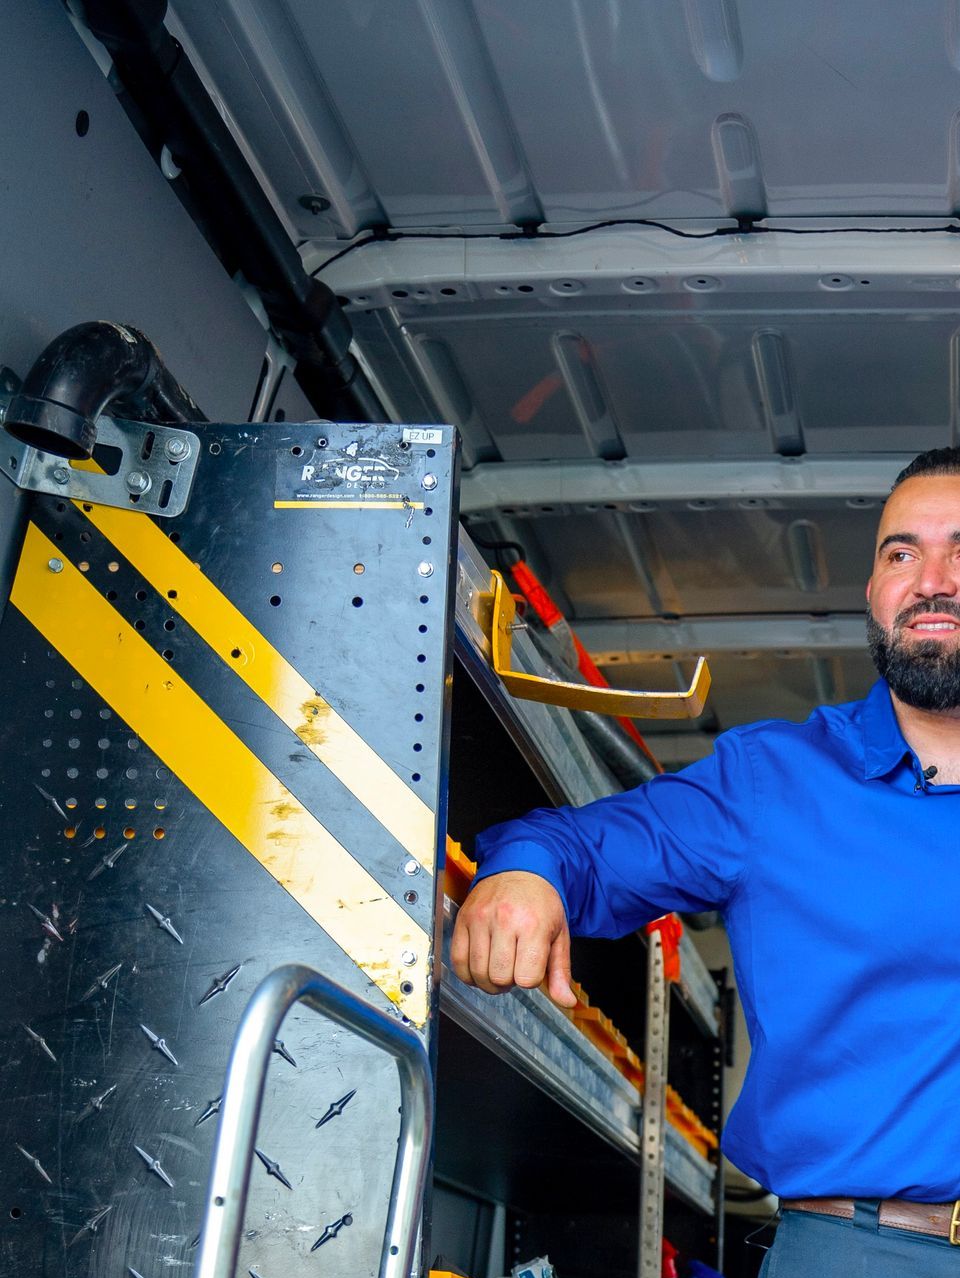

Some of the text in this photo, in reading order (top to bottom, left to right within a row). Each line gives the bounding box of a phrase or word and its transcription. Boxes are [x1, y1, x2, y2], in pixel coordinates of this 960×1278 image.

[408, 431, 435, 441] EZ UP
[301, 465, 385, 481] RNGER
